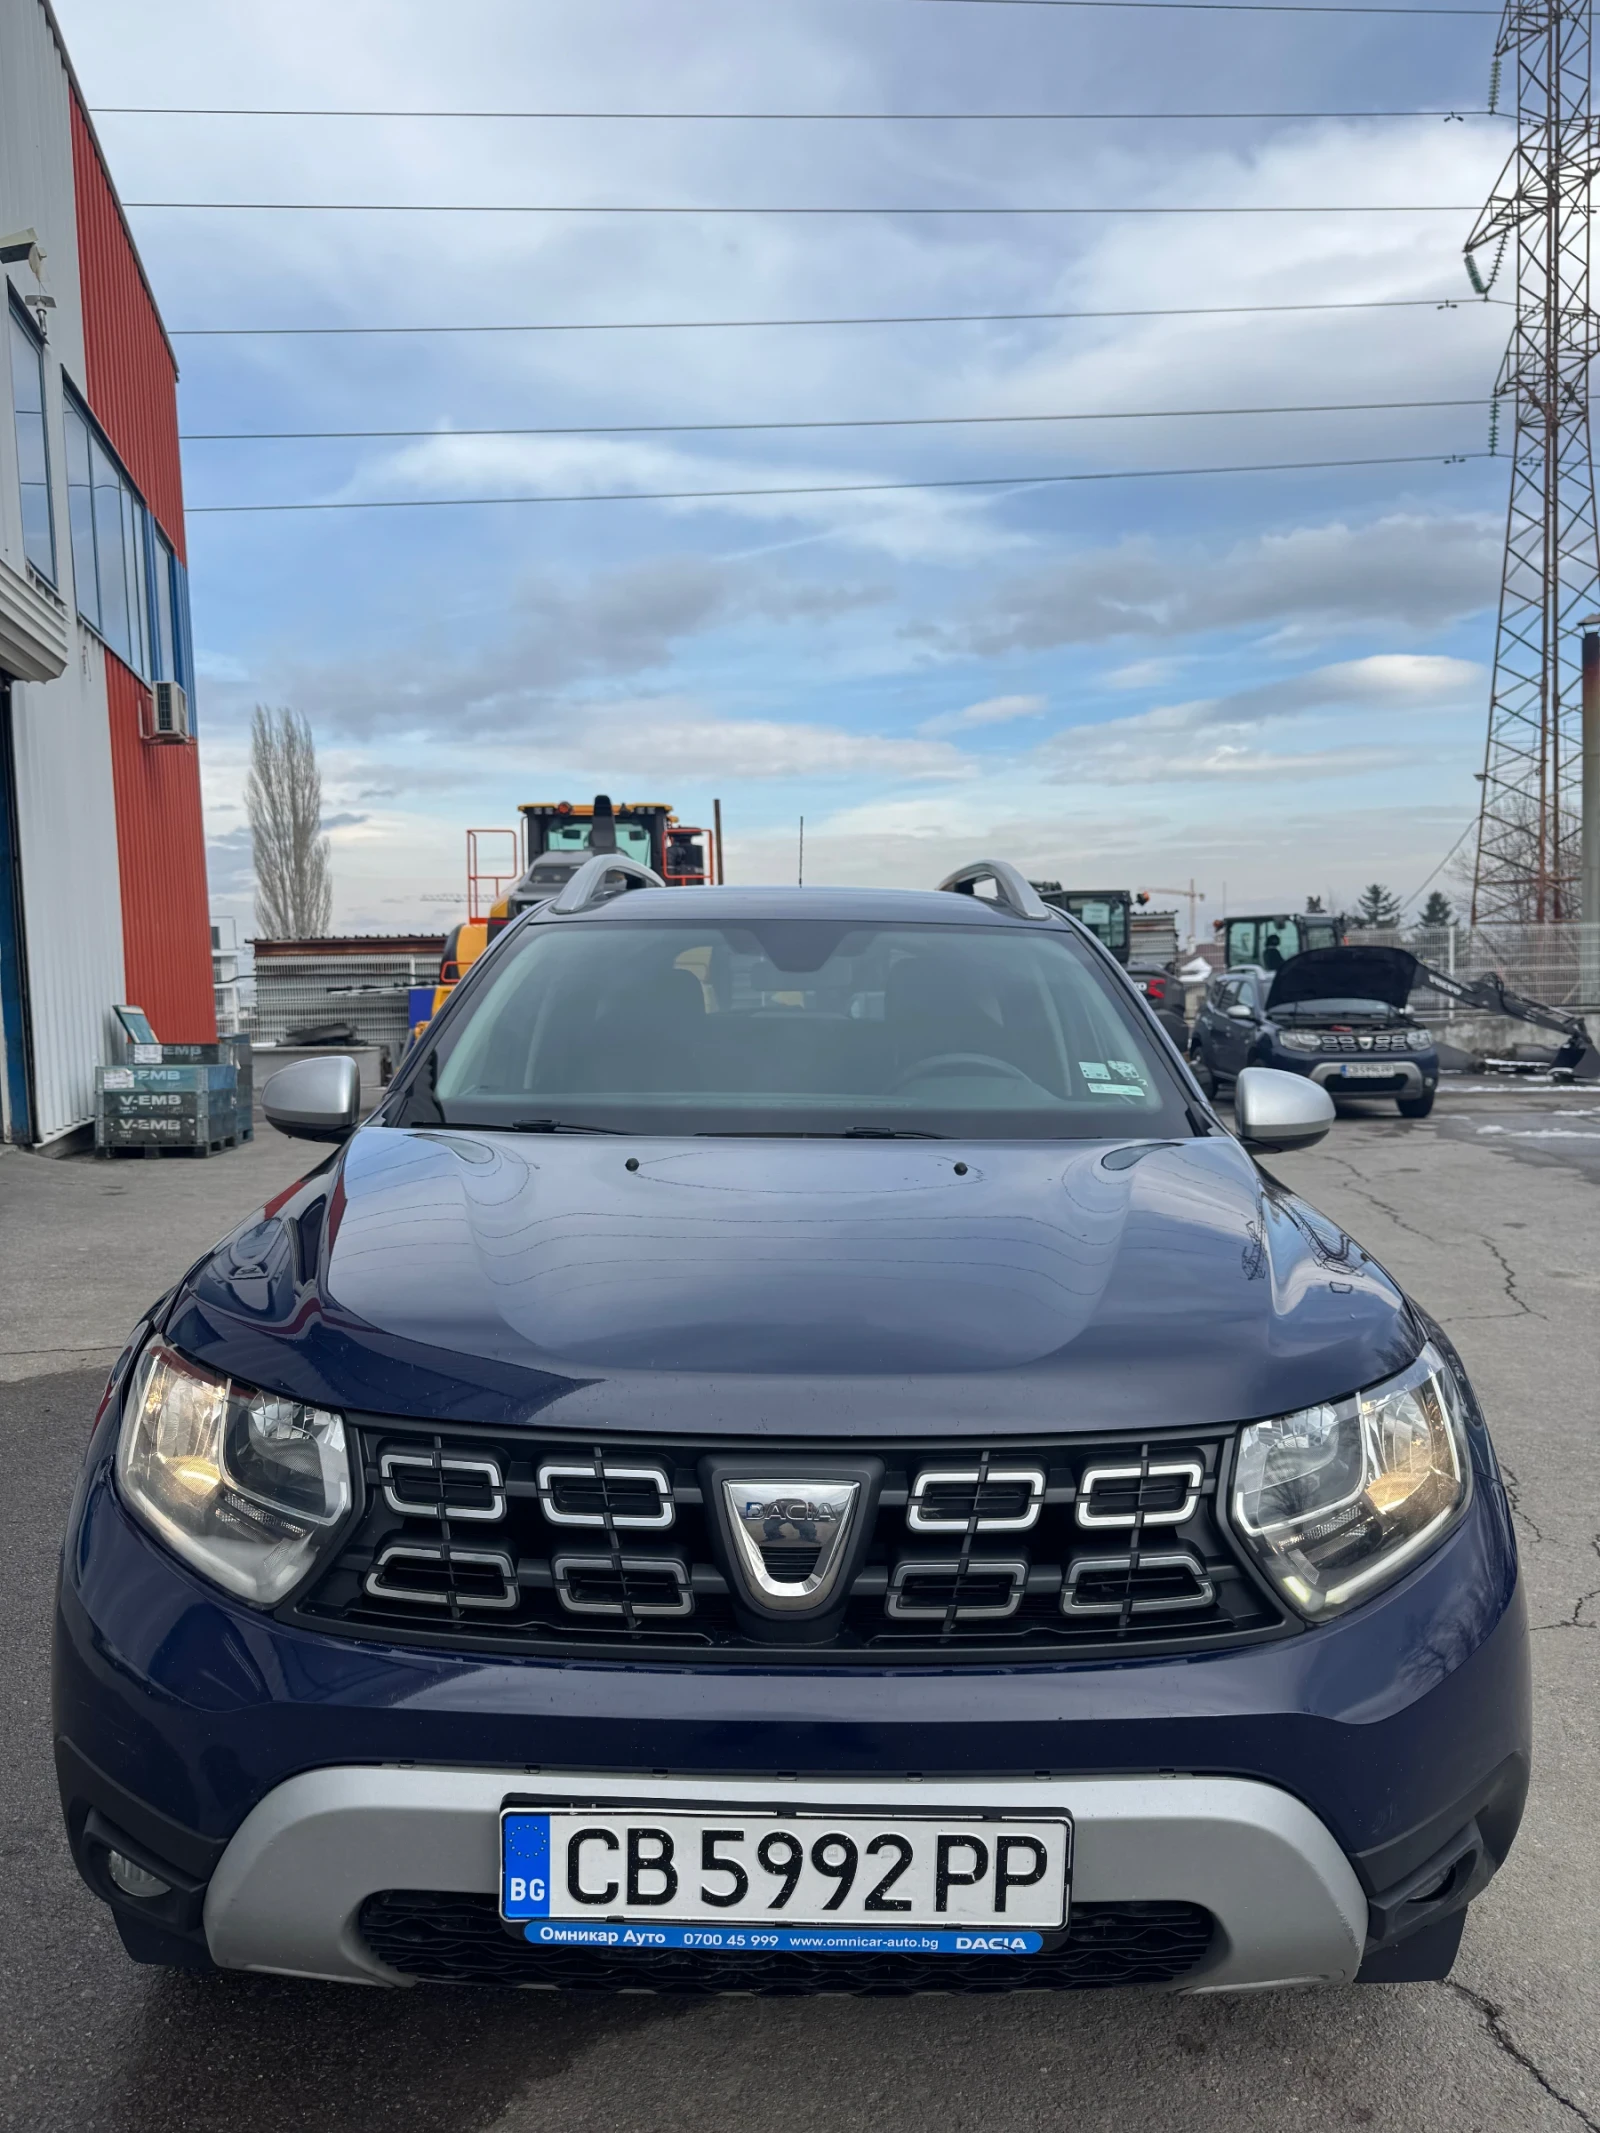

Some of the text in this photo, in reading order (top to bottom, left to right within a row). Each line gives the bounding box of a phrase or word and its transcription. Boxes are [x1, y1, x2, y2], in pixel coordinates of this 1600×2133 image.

[163, 1045, 202, 1056] EMB
[134, 1070, 181, 1081] -EMB
[120, 1094, 182, 1106] V-EMB
[119, 1119, 181, 1131] V-EMB
[746, 1502, 836, 1521] DACIA
[701, 1829, 914, 1912] 5992
[510, 1878, 546, 1901] BG
[540, 1926, 1027, 1950] Омникар Ауто 0700 45 999 www.omnicar-auto.bg DACIA
